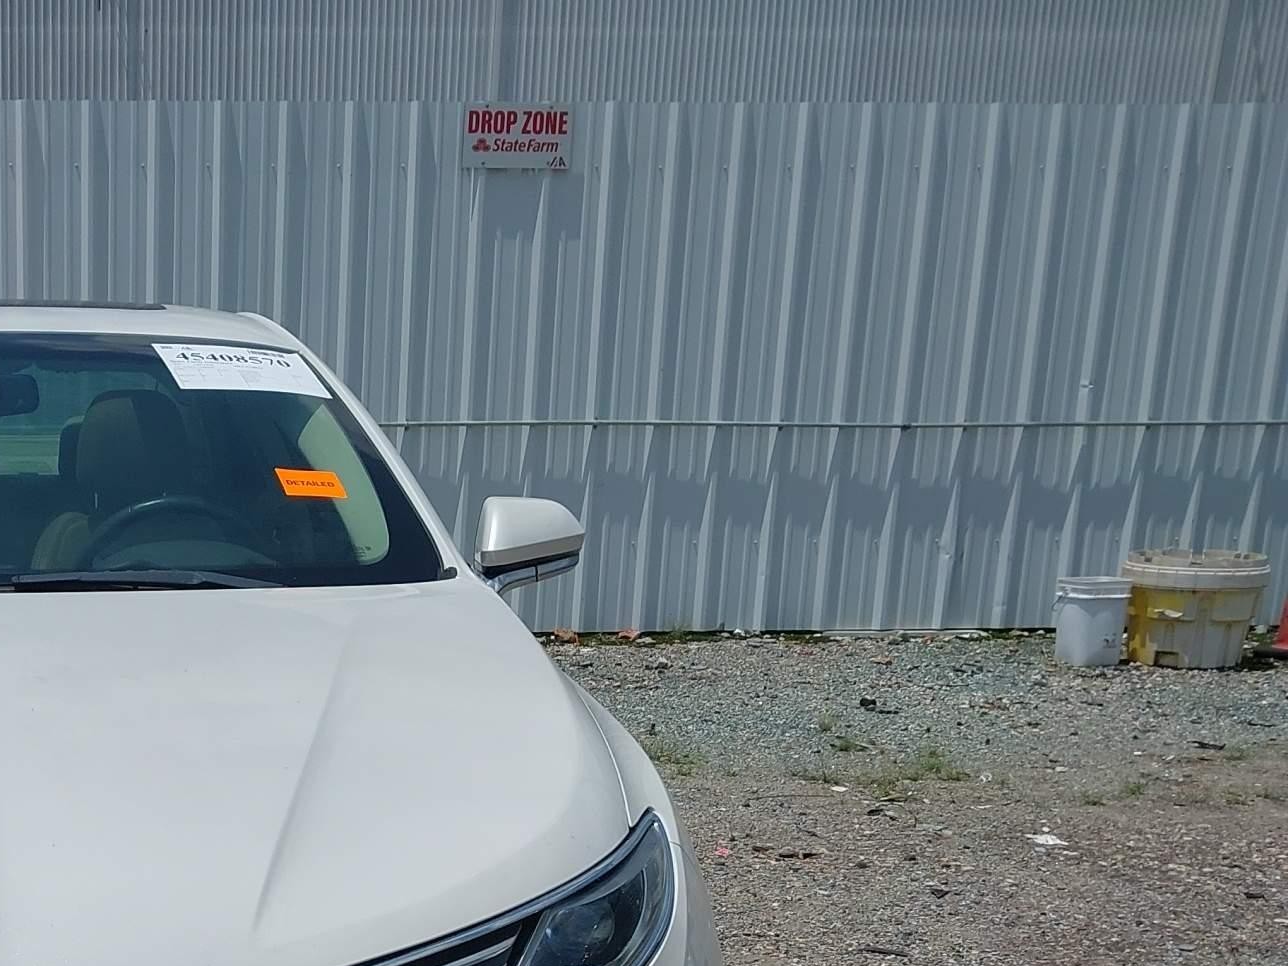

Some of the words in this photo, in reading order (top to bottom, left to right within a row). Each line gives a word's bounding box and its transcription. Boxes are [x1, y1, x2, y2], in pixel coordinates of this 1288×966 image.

[468, 110, 518, 134] DROP
[521, 110, 569, 135] ZONE
[175, 351, 292, 369] 45408570
[285, 479, 336, 488] DETAILED
